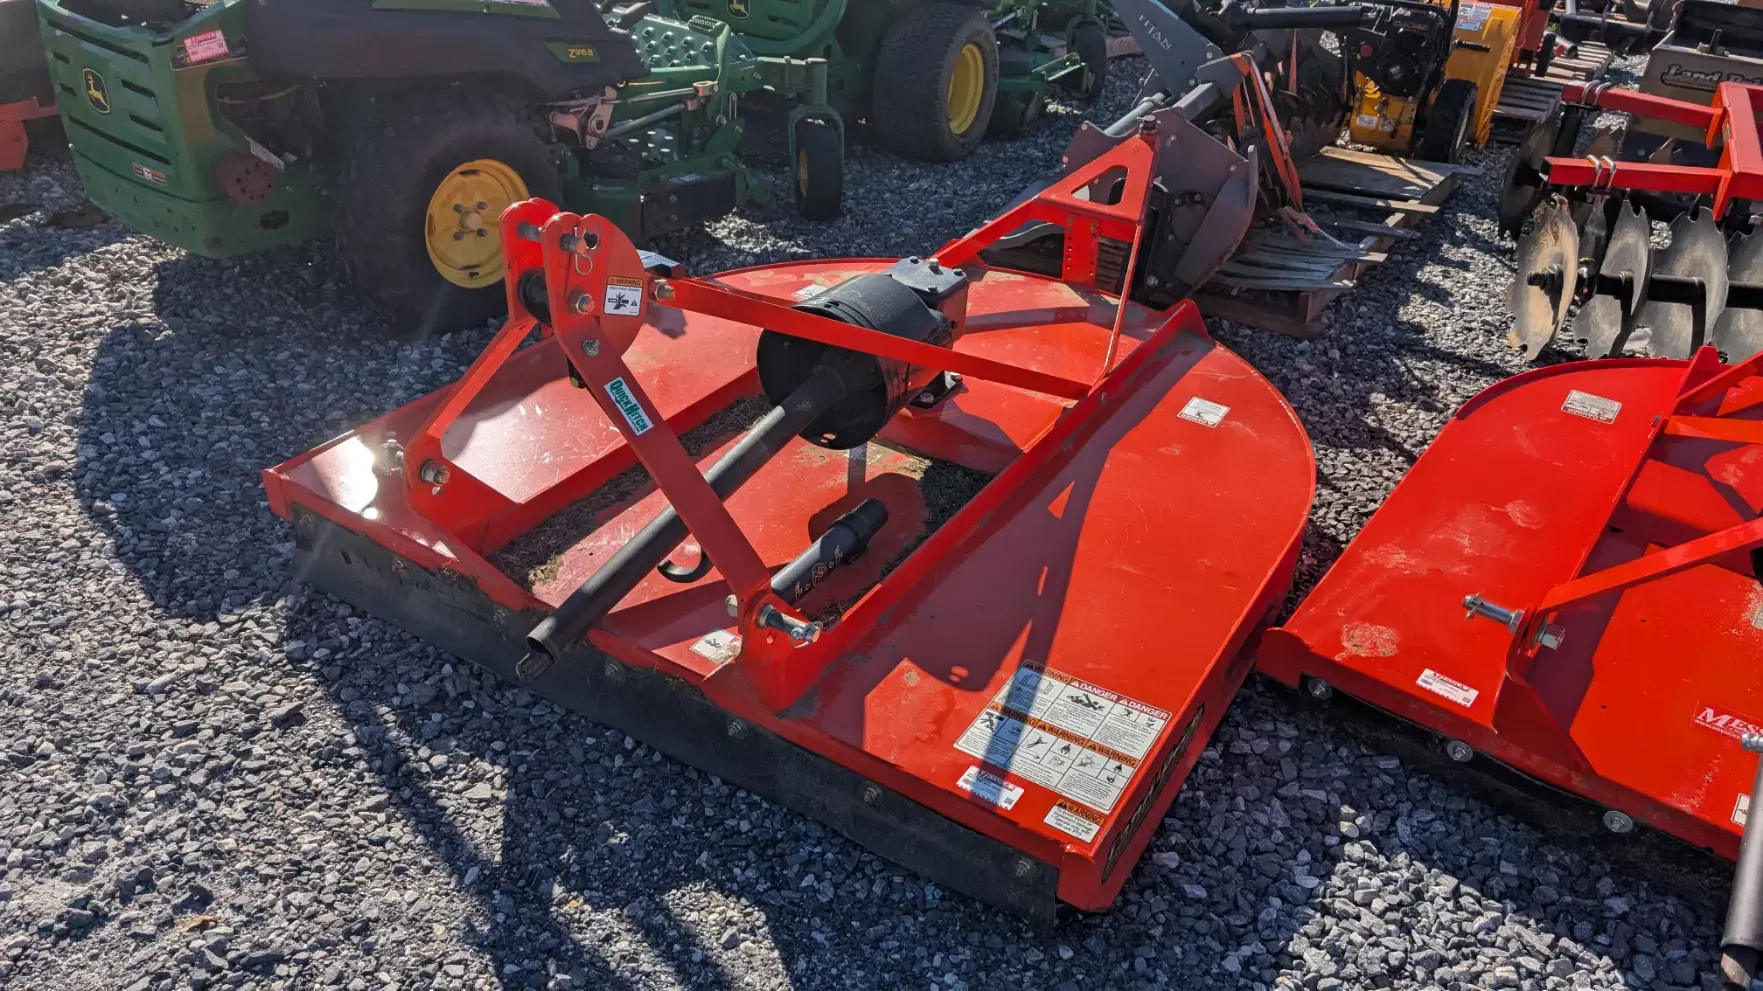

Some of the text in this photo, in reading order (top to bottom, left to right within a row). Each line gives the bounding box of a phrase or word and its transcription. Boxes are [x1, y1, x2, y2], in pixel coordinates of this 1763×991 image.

[1138, 13, 1173, 51] TITAN
[1663, 64, 1722, 86] Land
[1079, 682, 1118, 702] DANGER
[1128, 699, 1169, 720] DANGER
[1047, 726, 1086, 746] WARNING
[1096, 744, 1137, 767] WARNING
[1067, 803, 1102, 824] WARNING
